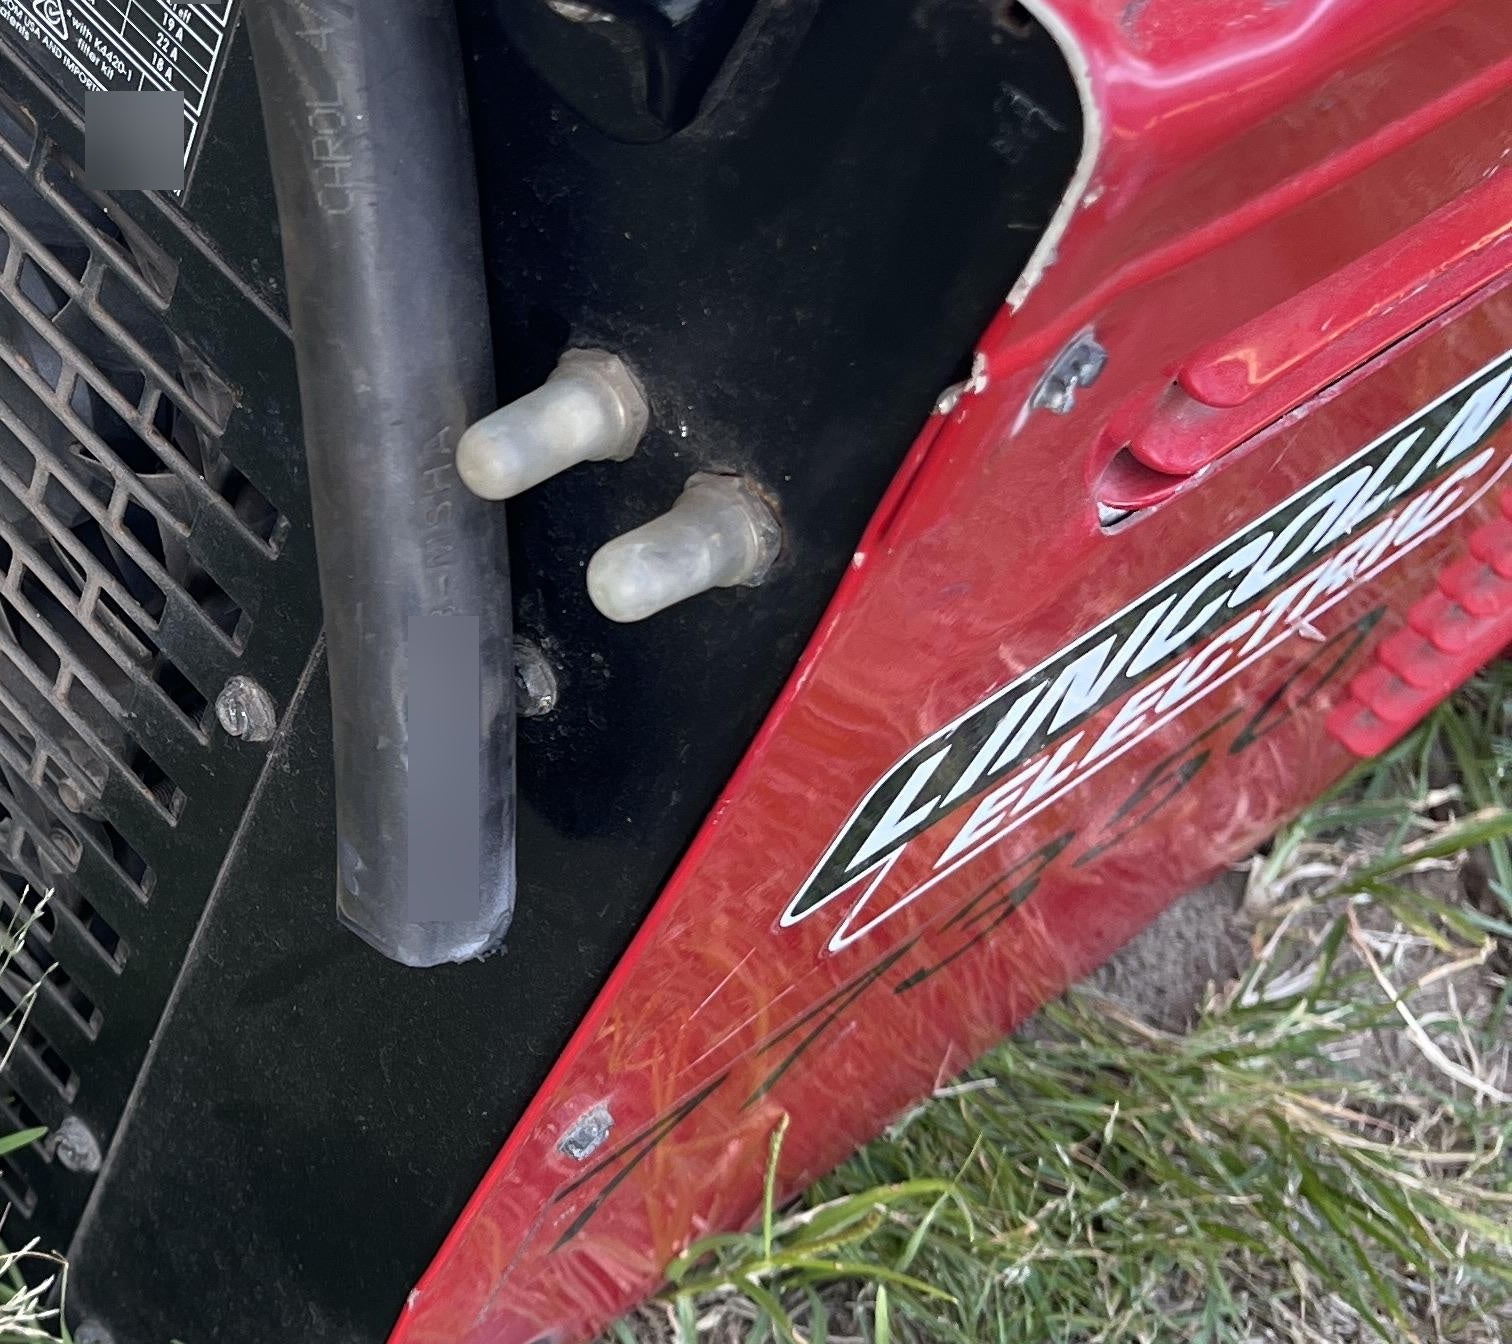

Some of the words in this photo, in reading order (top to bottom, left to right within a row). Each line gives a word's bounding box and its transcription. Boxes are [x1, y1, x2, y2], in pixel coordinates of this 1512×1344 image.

[23, 15, 40, 39] USA
[41, 35, 62, 59] AND
[155, 31, 170, 53] 22
[169, 46, 178, 62] A
[162, 11, 175, 31] 19
[174, 26, 183, 42] A
[77, 37, 104, 69] filter
[103, 65, 114, 80] kit
[93, 37, 132, 81] K4420-1
[151, 51, 164, 71] 18
[164, 66, 172, 82] A
[845, 366, 1512, 873] LINCOLN
[932, 447, 1496, 870] ELECTRIC
